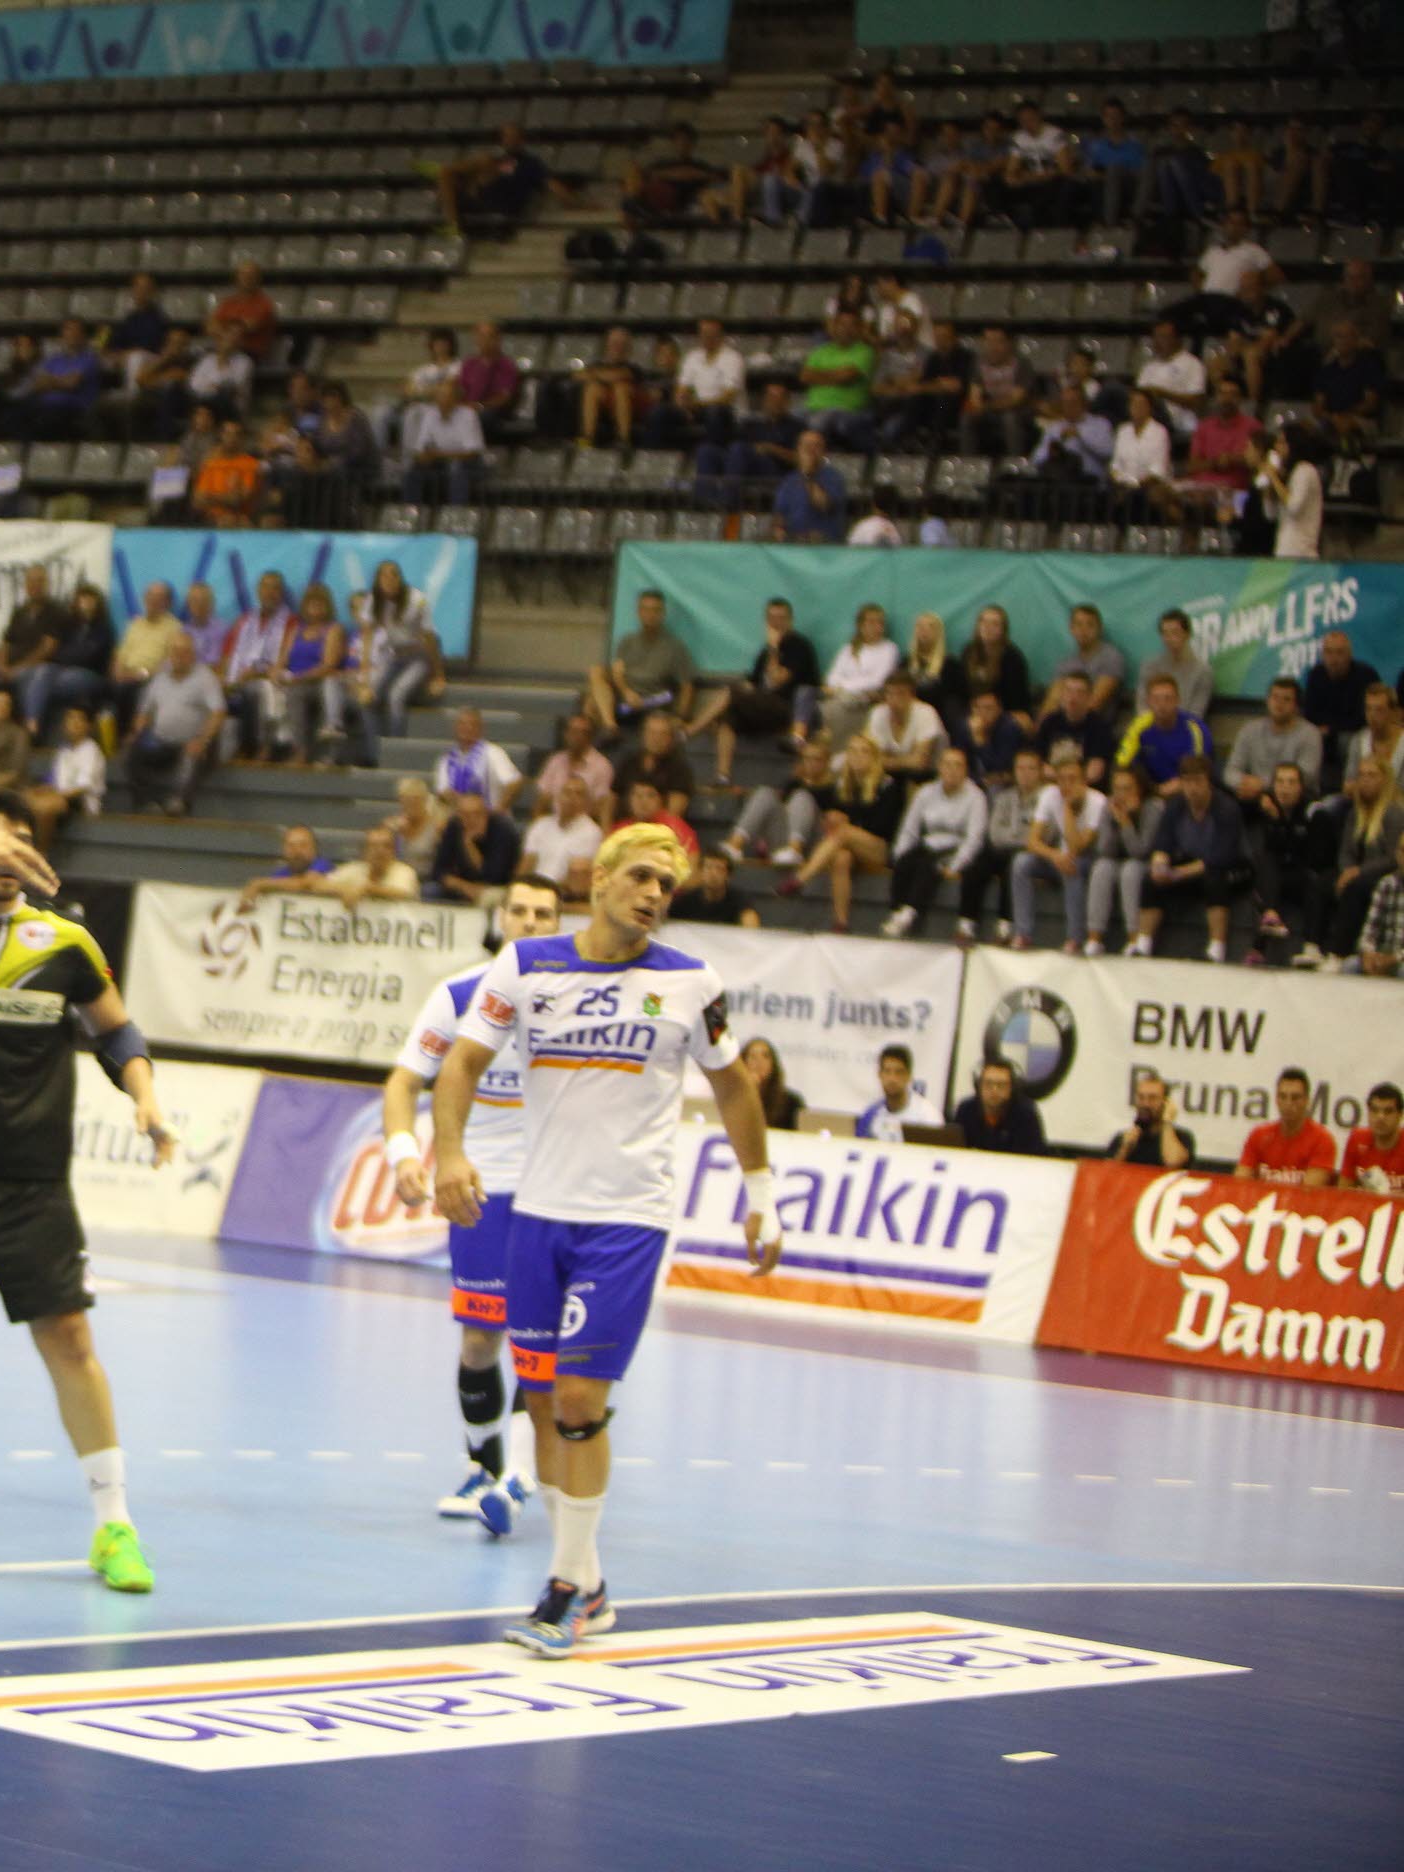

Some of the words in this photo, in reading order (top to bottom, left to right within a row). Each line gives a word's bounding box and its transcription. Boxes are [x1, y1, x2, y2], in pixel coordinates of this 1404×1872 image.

[279, 900, 455, 950] Estabanell
[271, 955, 403, 1010] Energia
[576, 984, 631, 1018] 25
[203, 1005, 286, 1041] sempre
[823, 990, 932, 1033] junts?
[1132, 1000, 1268, 1054] BMW
[1163, 1269, 1387, 1374] Damm
